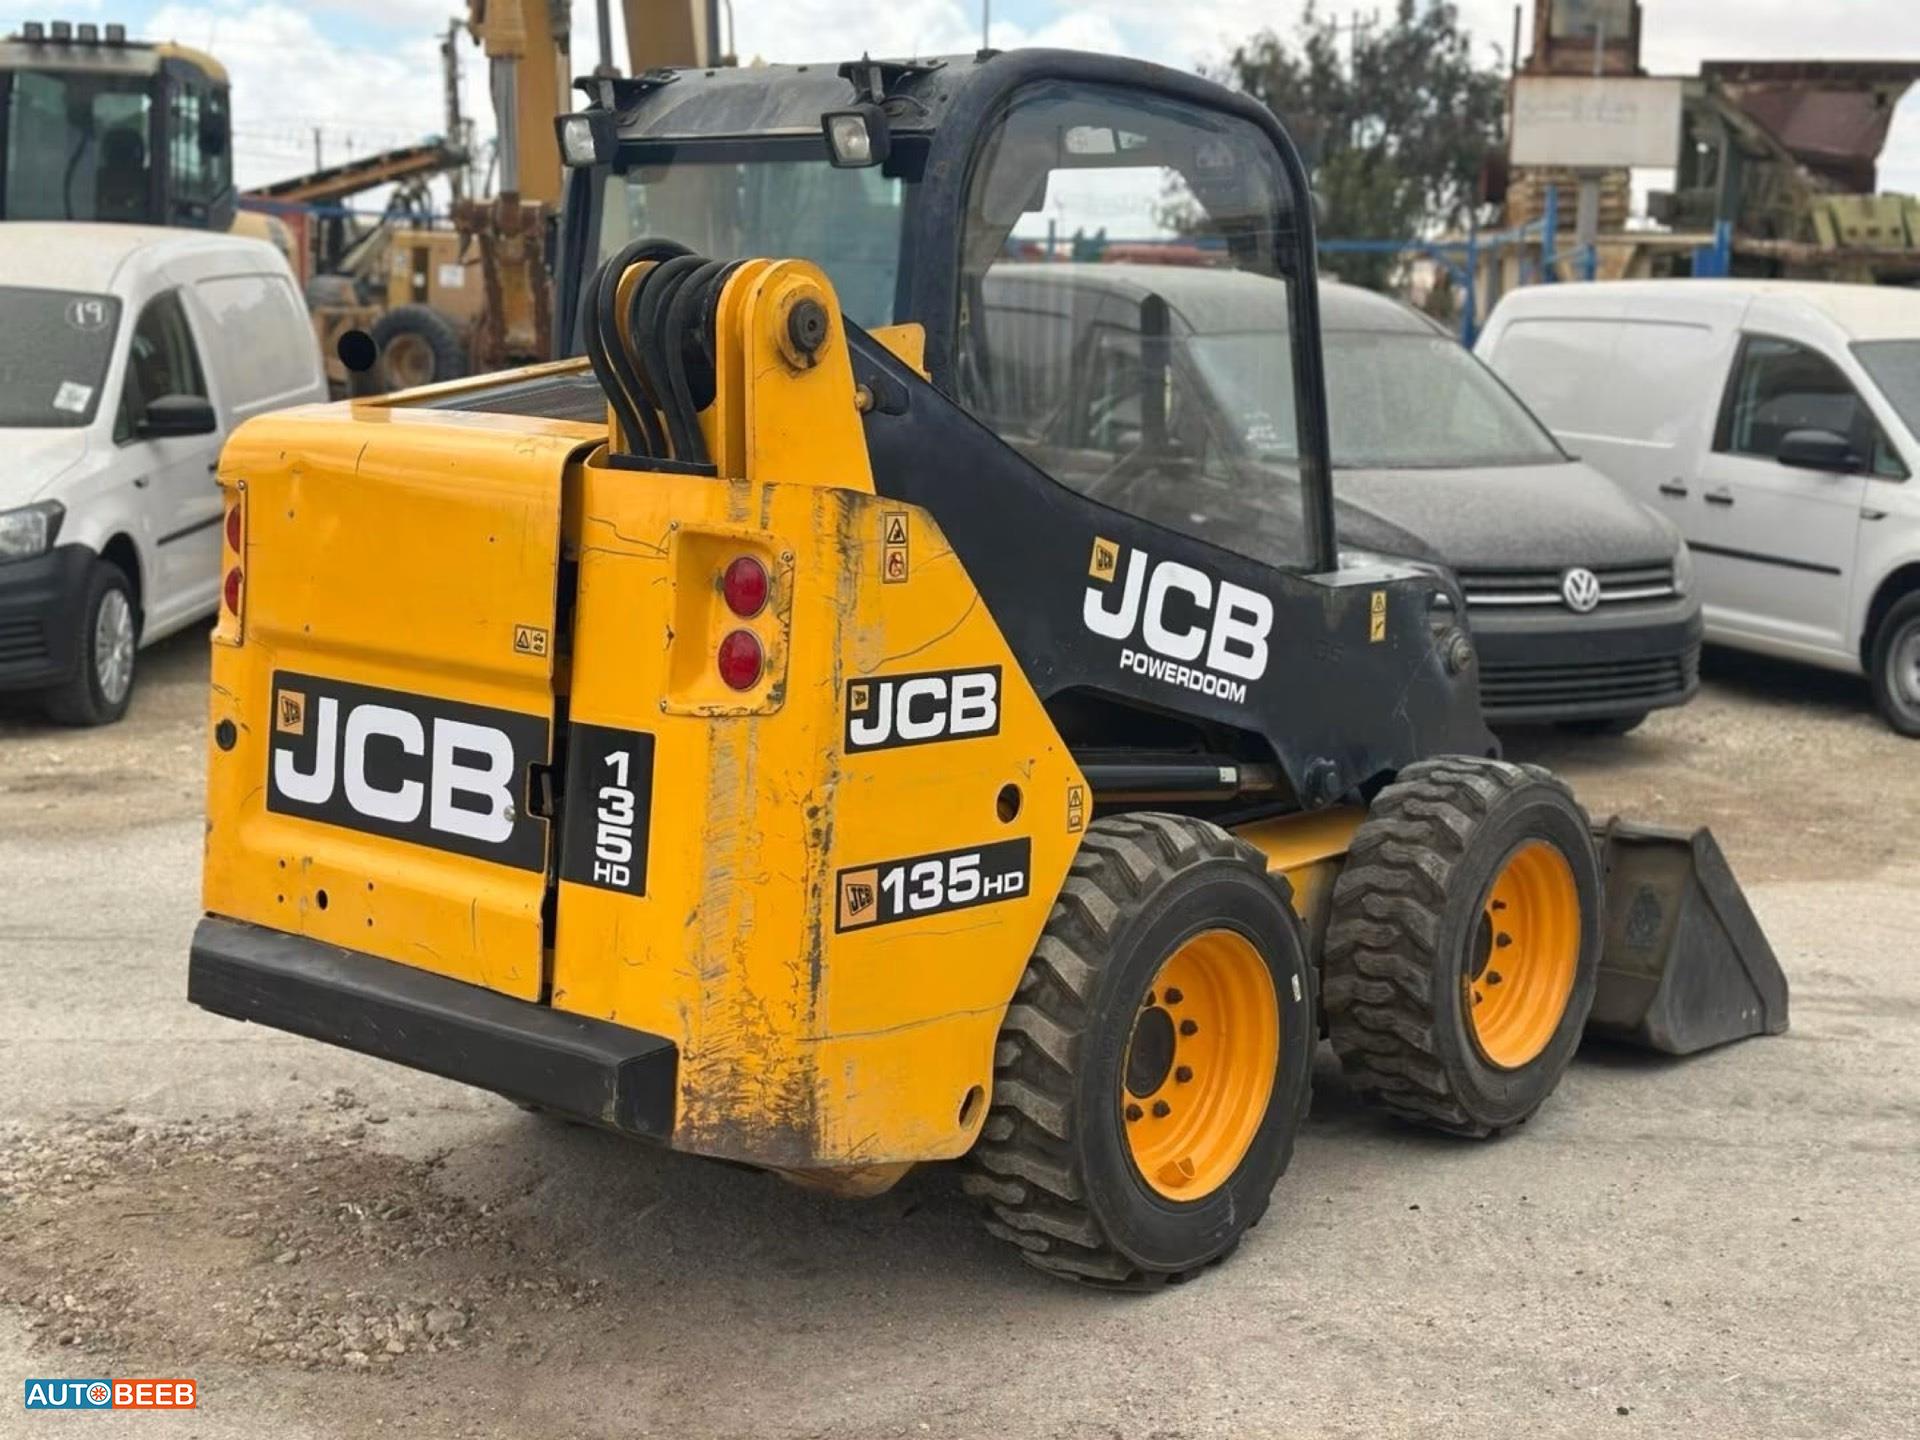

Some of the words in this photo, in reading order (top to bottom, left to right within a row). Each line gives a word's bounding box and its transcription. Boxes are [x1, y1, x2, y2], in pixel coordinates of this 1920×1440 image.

[76, 301, 102, 324] 19
[1084, 548, 1274, 681] JCB
[1120, 648, 1247, 704] POWERDOOM
[850, 673, 997, 745] JCB
[275, 697, 515, 843] JCB
[849, 886, 874, 913] JCB
